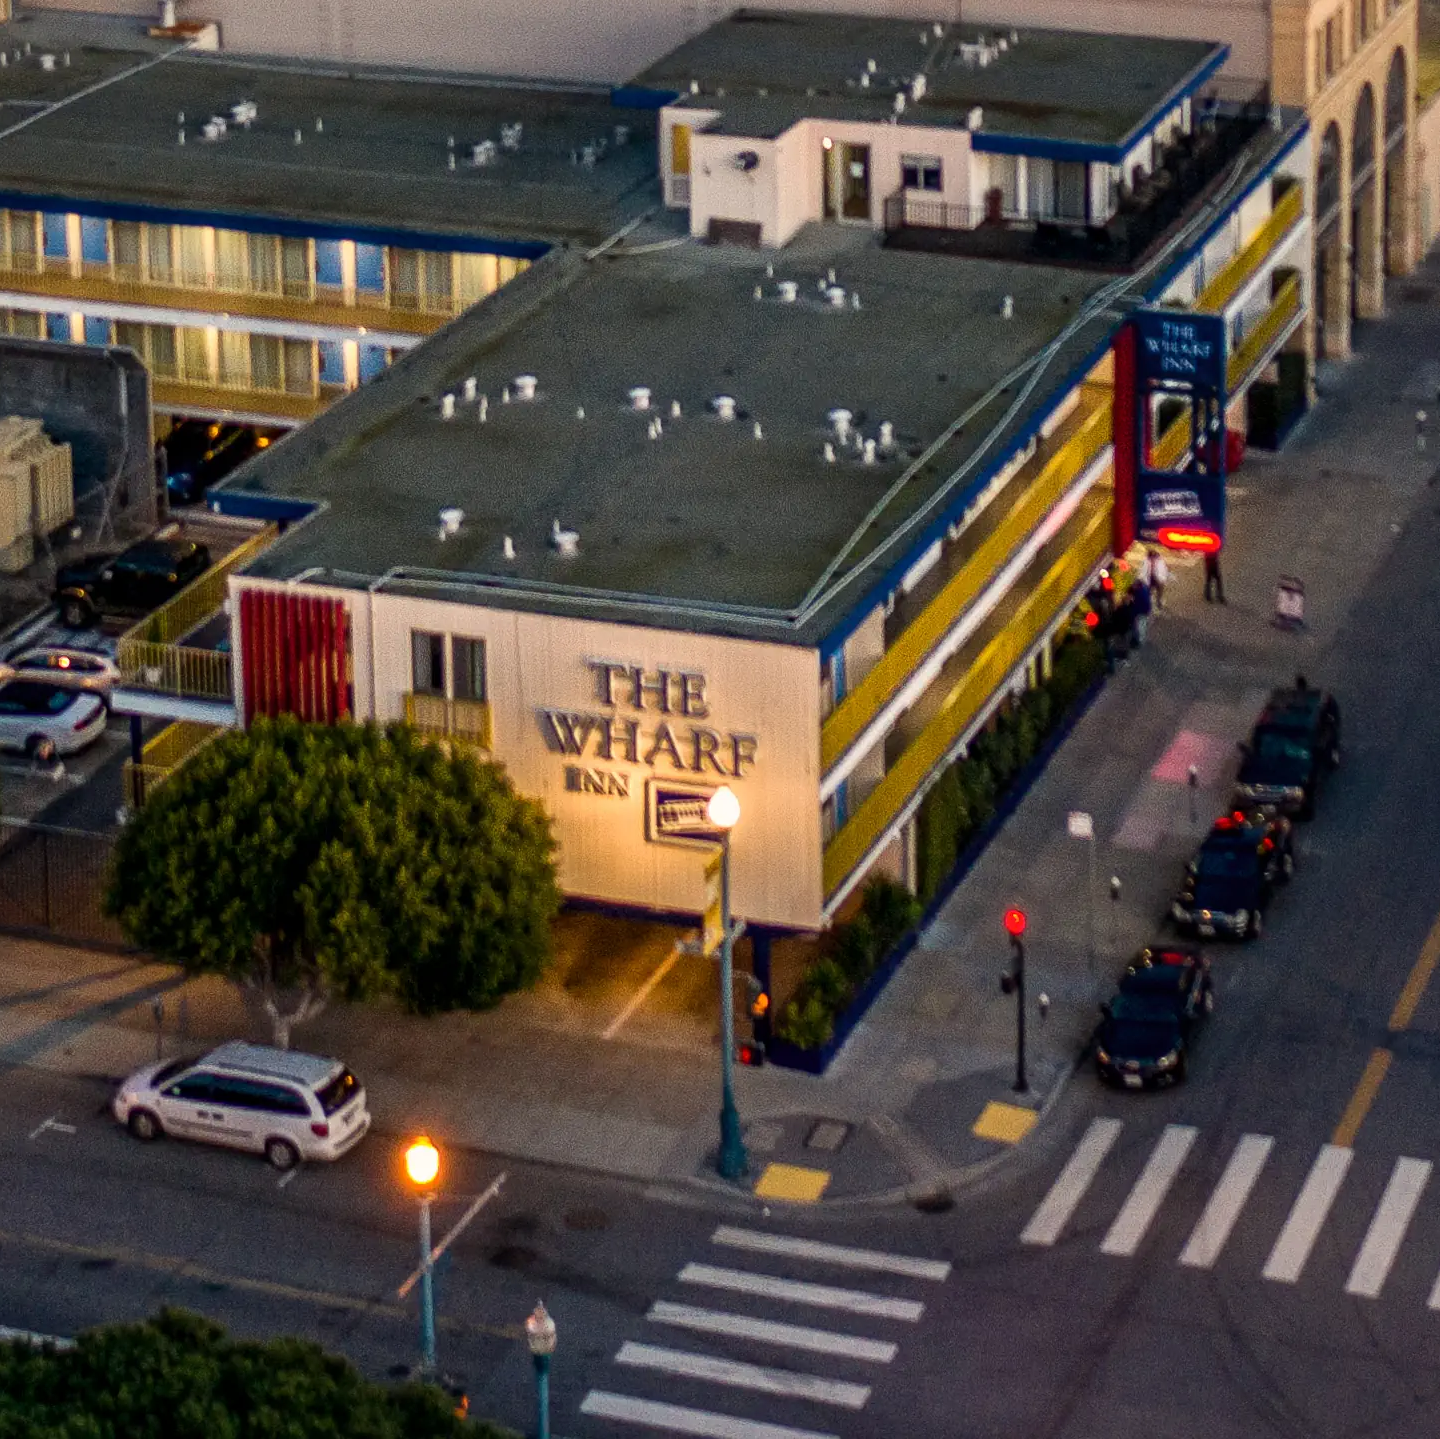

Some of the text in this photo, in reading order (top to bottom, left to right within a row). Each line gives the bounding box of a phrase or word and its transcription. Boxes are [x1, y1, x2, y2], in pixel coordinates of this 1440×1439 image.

[583, 655, 709, 718] THE
[537, 706, 758, 777] WHARF
[564, 765, 629, 796] INN
